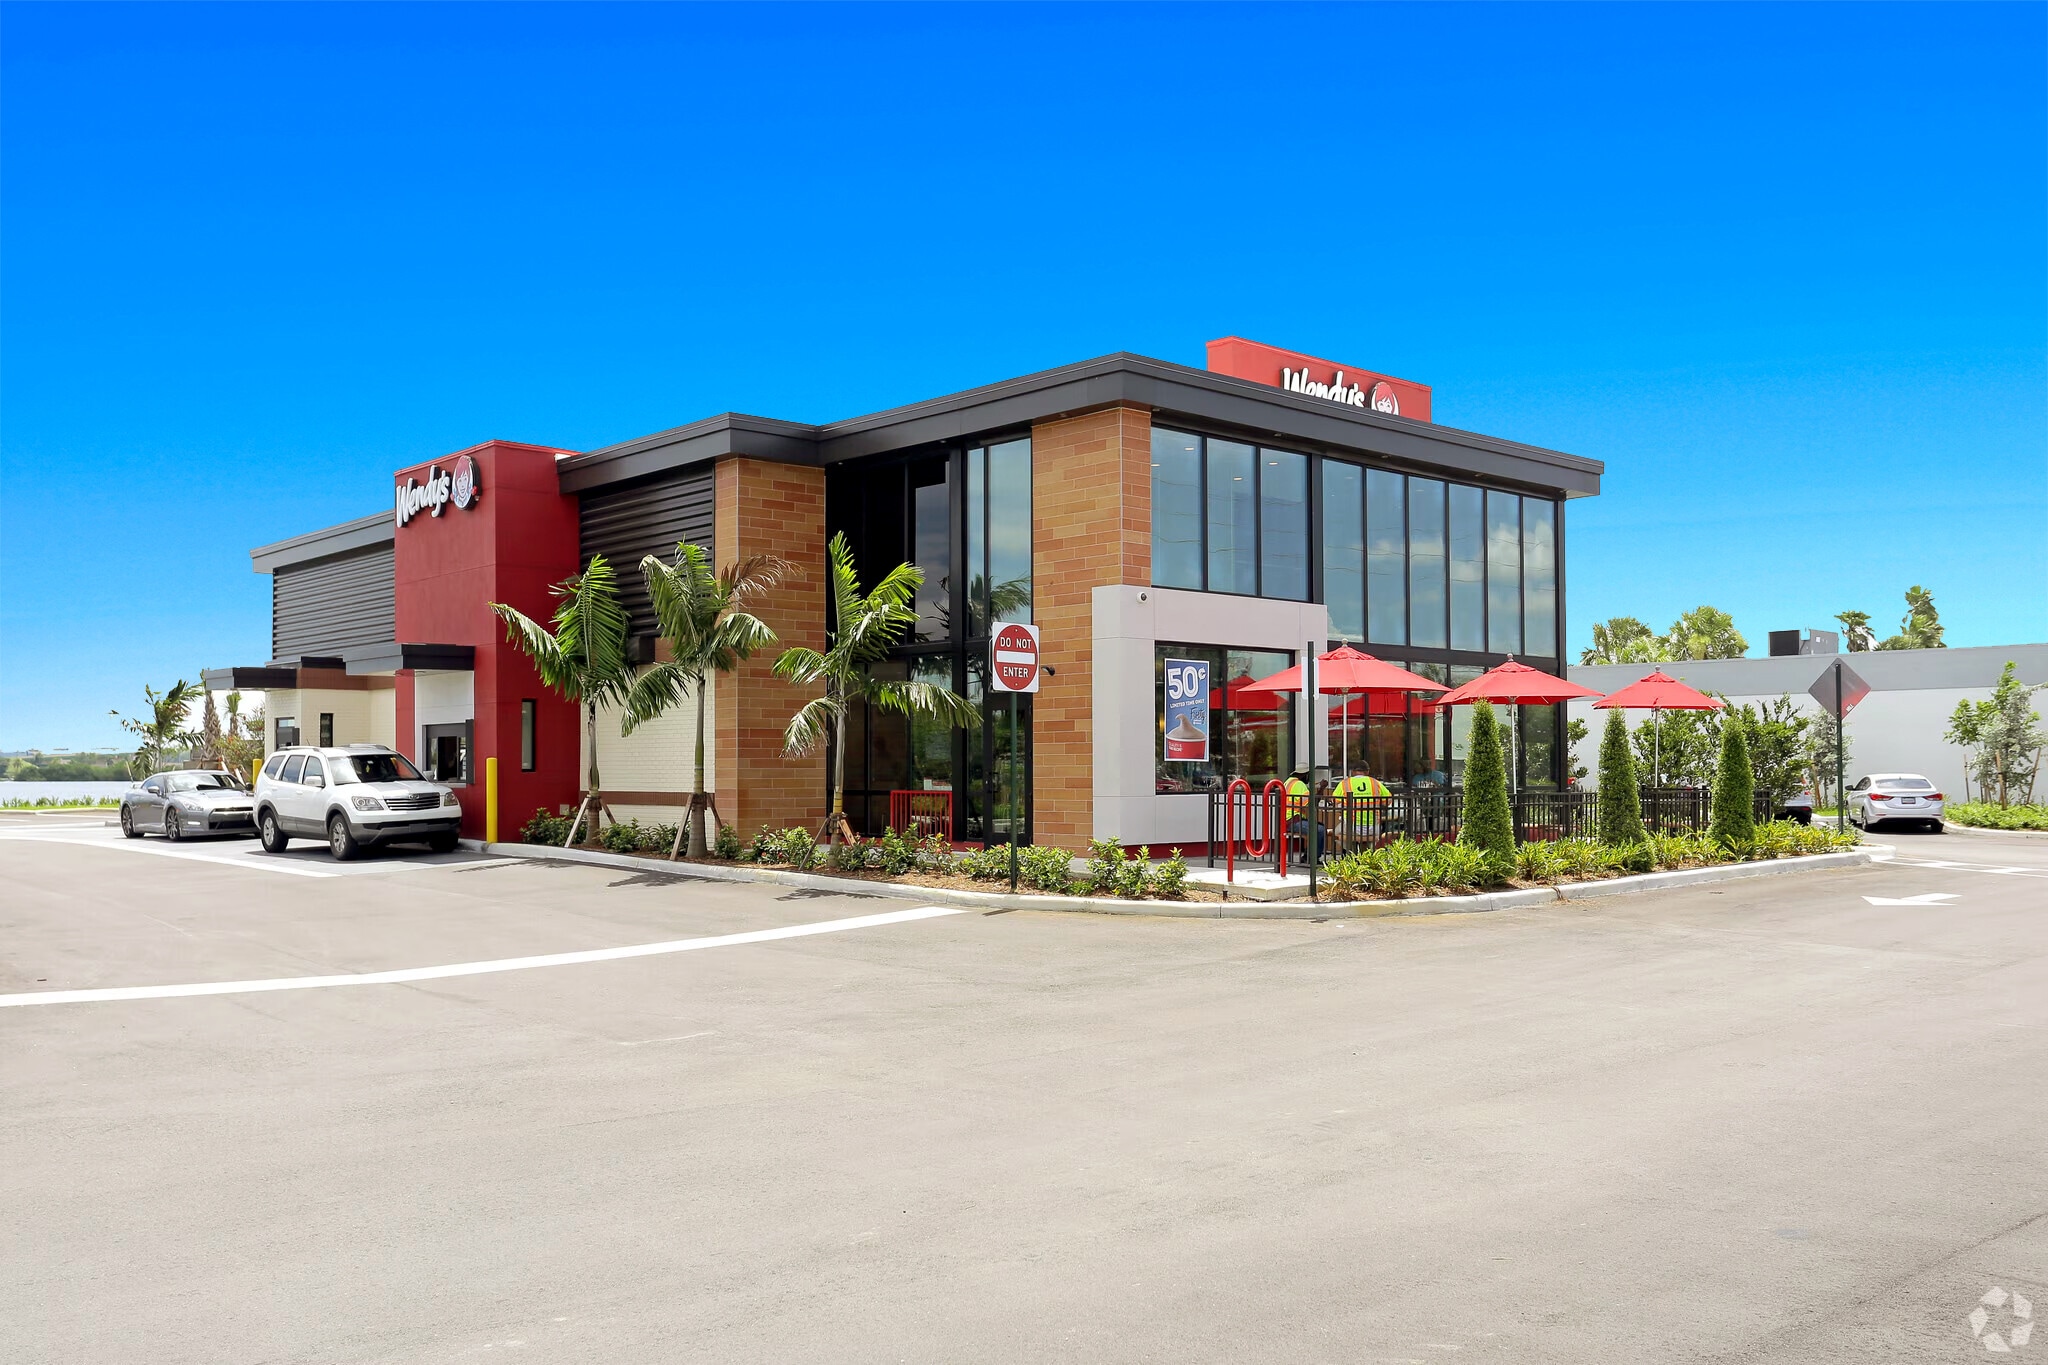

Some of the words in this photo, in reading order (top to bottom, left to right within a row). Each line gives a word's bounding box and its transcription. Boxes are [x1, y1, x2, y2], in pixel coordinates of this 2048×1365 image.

[396, 464, 450, 528] Wendy's
[1000, 636, 1011, 647] DO
[1016, 638, 1032, 649] NOT
[1003, 666, 1029, 678] ENTER
[1169, 701, 1186, 709] LIMITED
[1357, 781, 1367, 792] J
